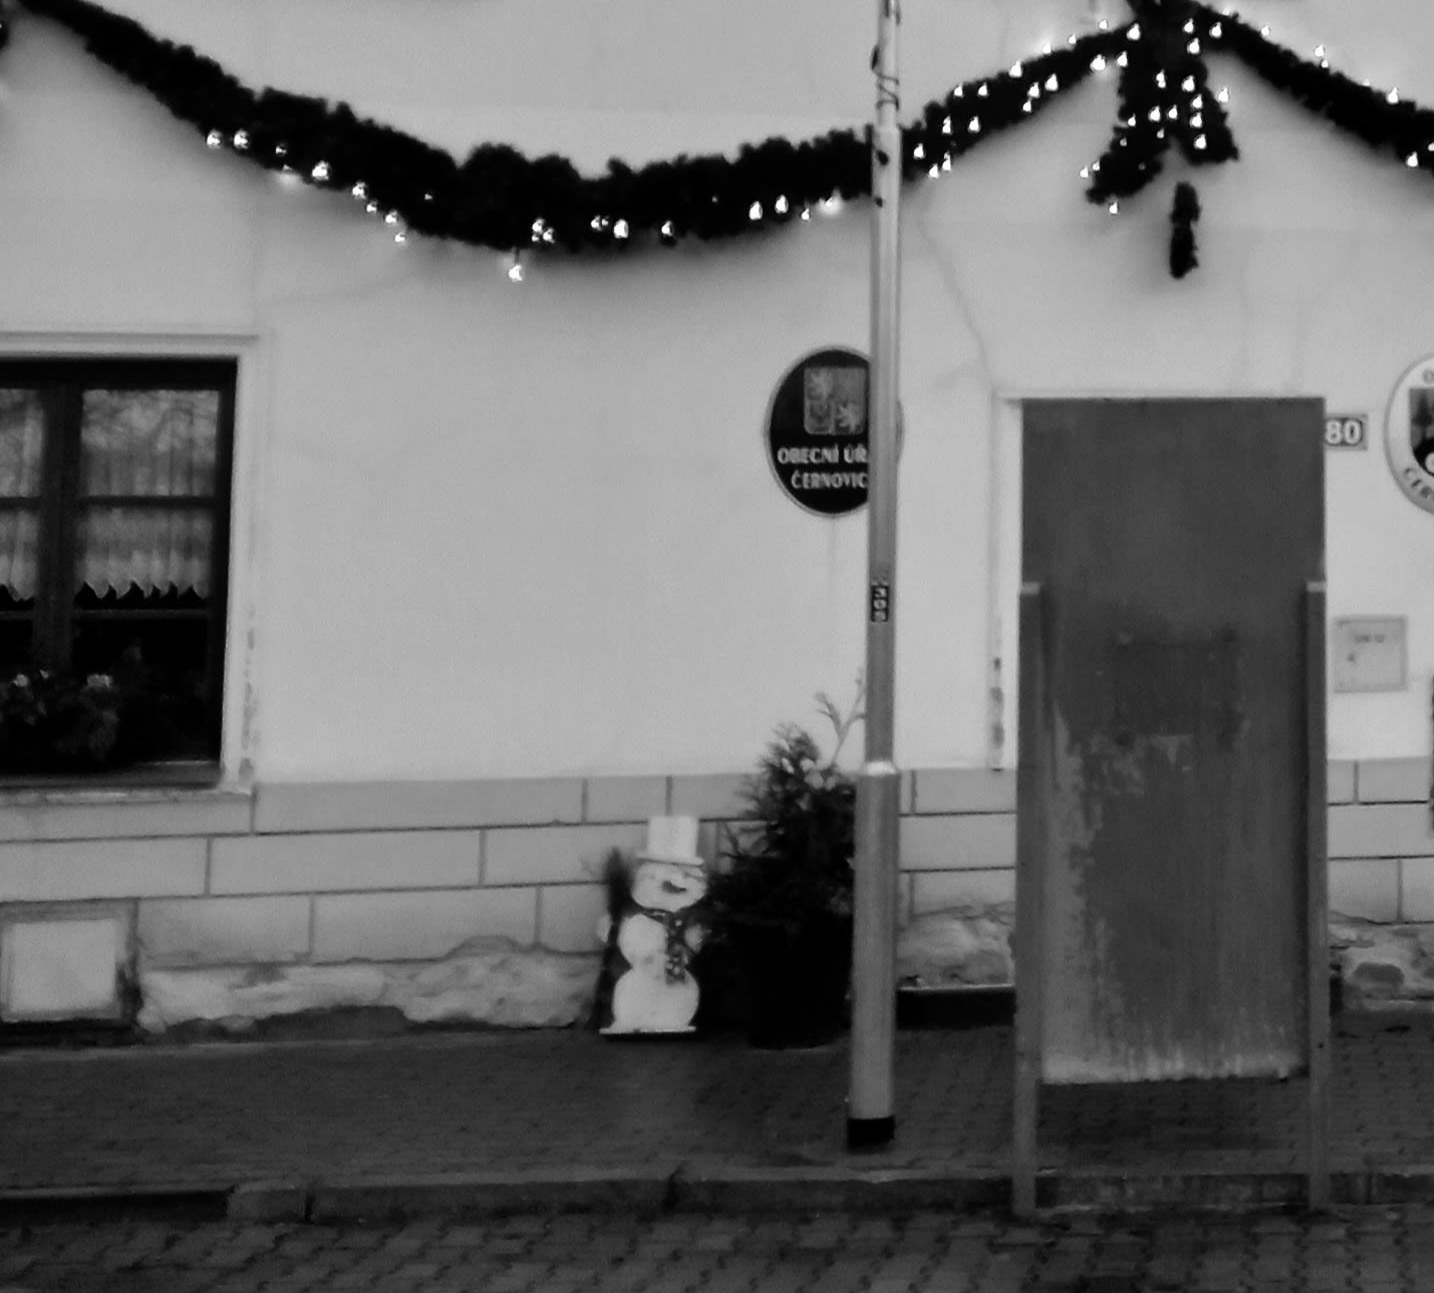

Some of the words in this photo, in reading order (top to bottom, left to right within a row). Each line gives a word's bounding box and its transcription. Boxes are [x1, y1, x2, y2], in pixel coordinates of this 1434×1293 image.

[1325, 418, 1361, 446] 80
[777, 444, 839, 464] OBECNÍ
[791, 469, 868, 489] ČERNOVIC
